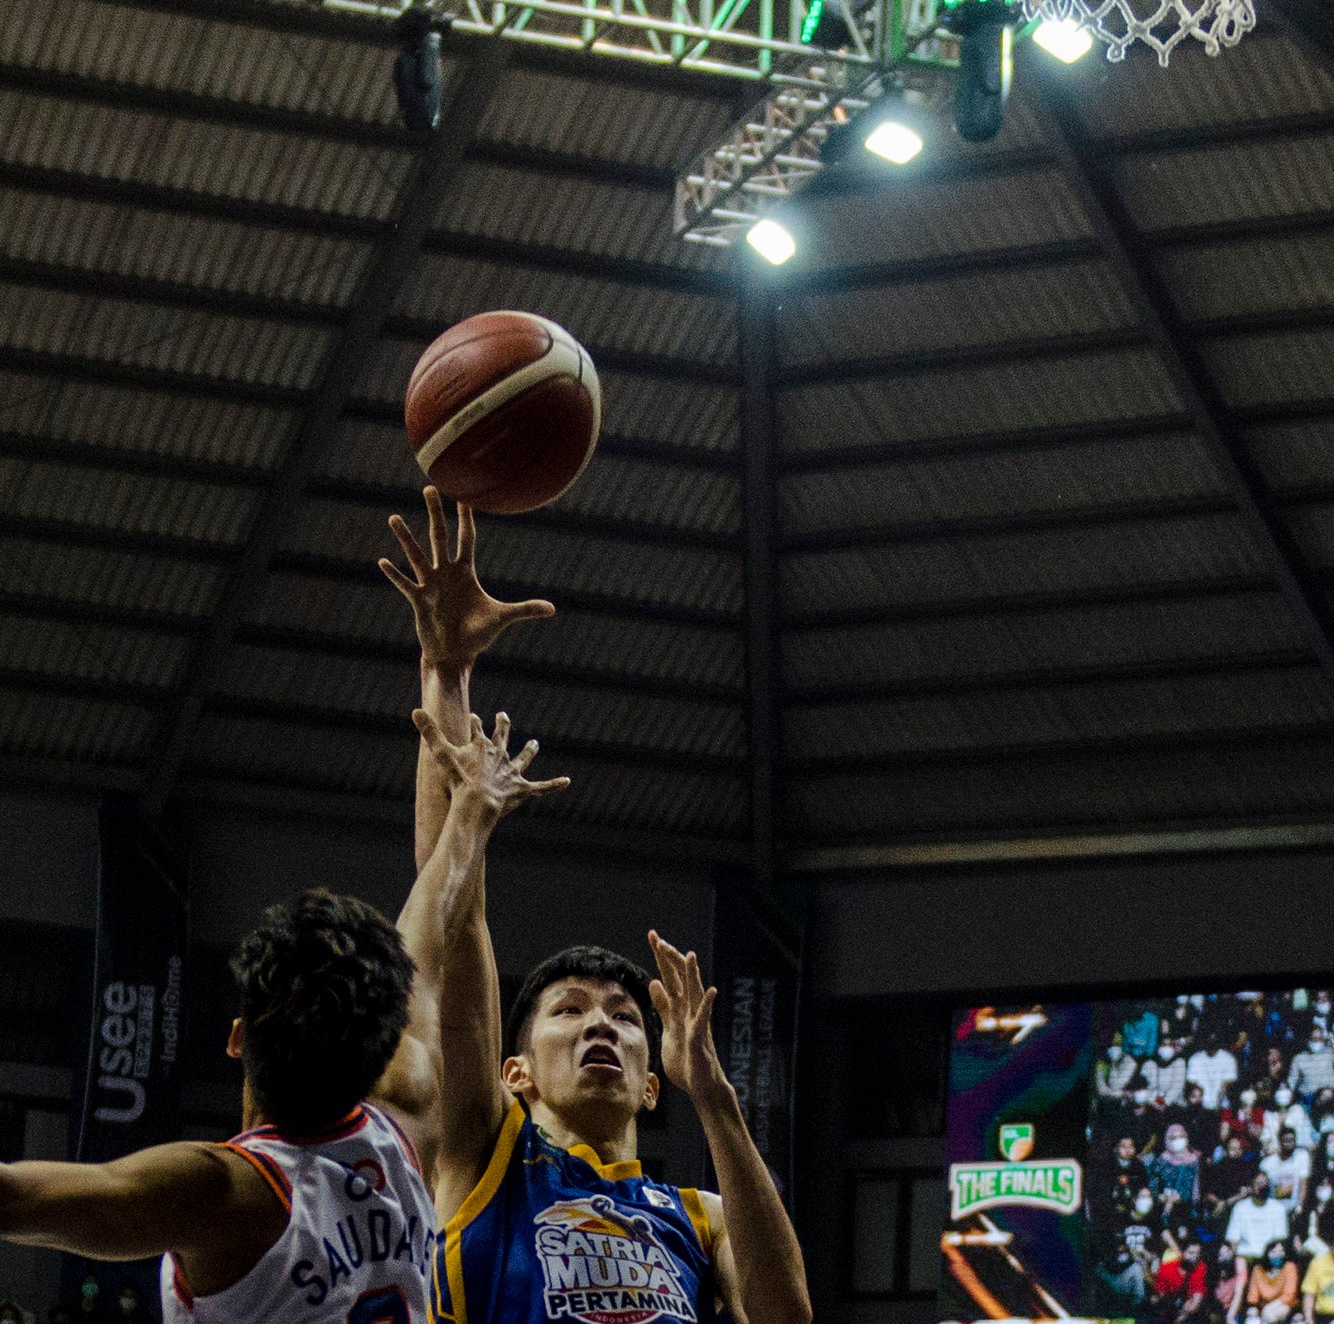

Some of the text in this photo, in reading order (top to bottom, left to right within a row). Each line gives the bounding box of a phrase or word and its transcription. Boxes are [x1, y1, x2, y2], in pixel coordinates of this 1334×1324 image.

[160, 954, 182, 1062] IndiHome
[93, 980, 146, 1122] Usee
[957, 1167, 1073, 1208] THE FINALS
[539, 1227, 670, 1270] SATRIA
[548, 1254, 680, 1297] MUDA
[549, 1291, 695, 1321] PERTAMINA
